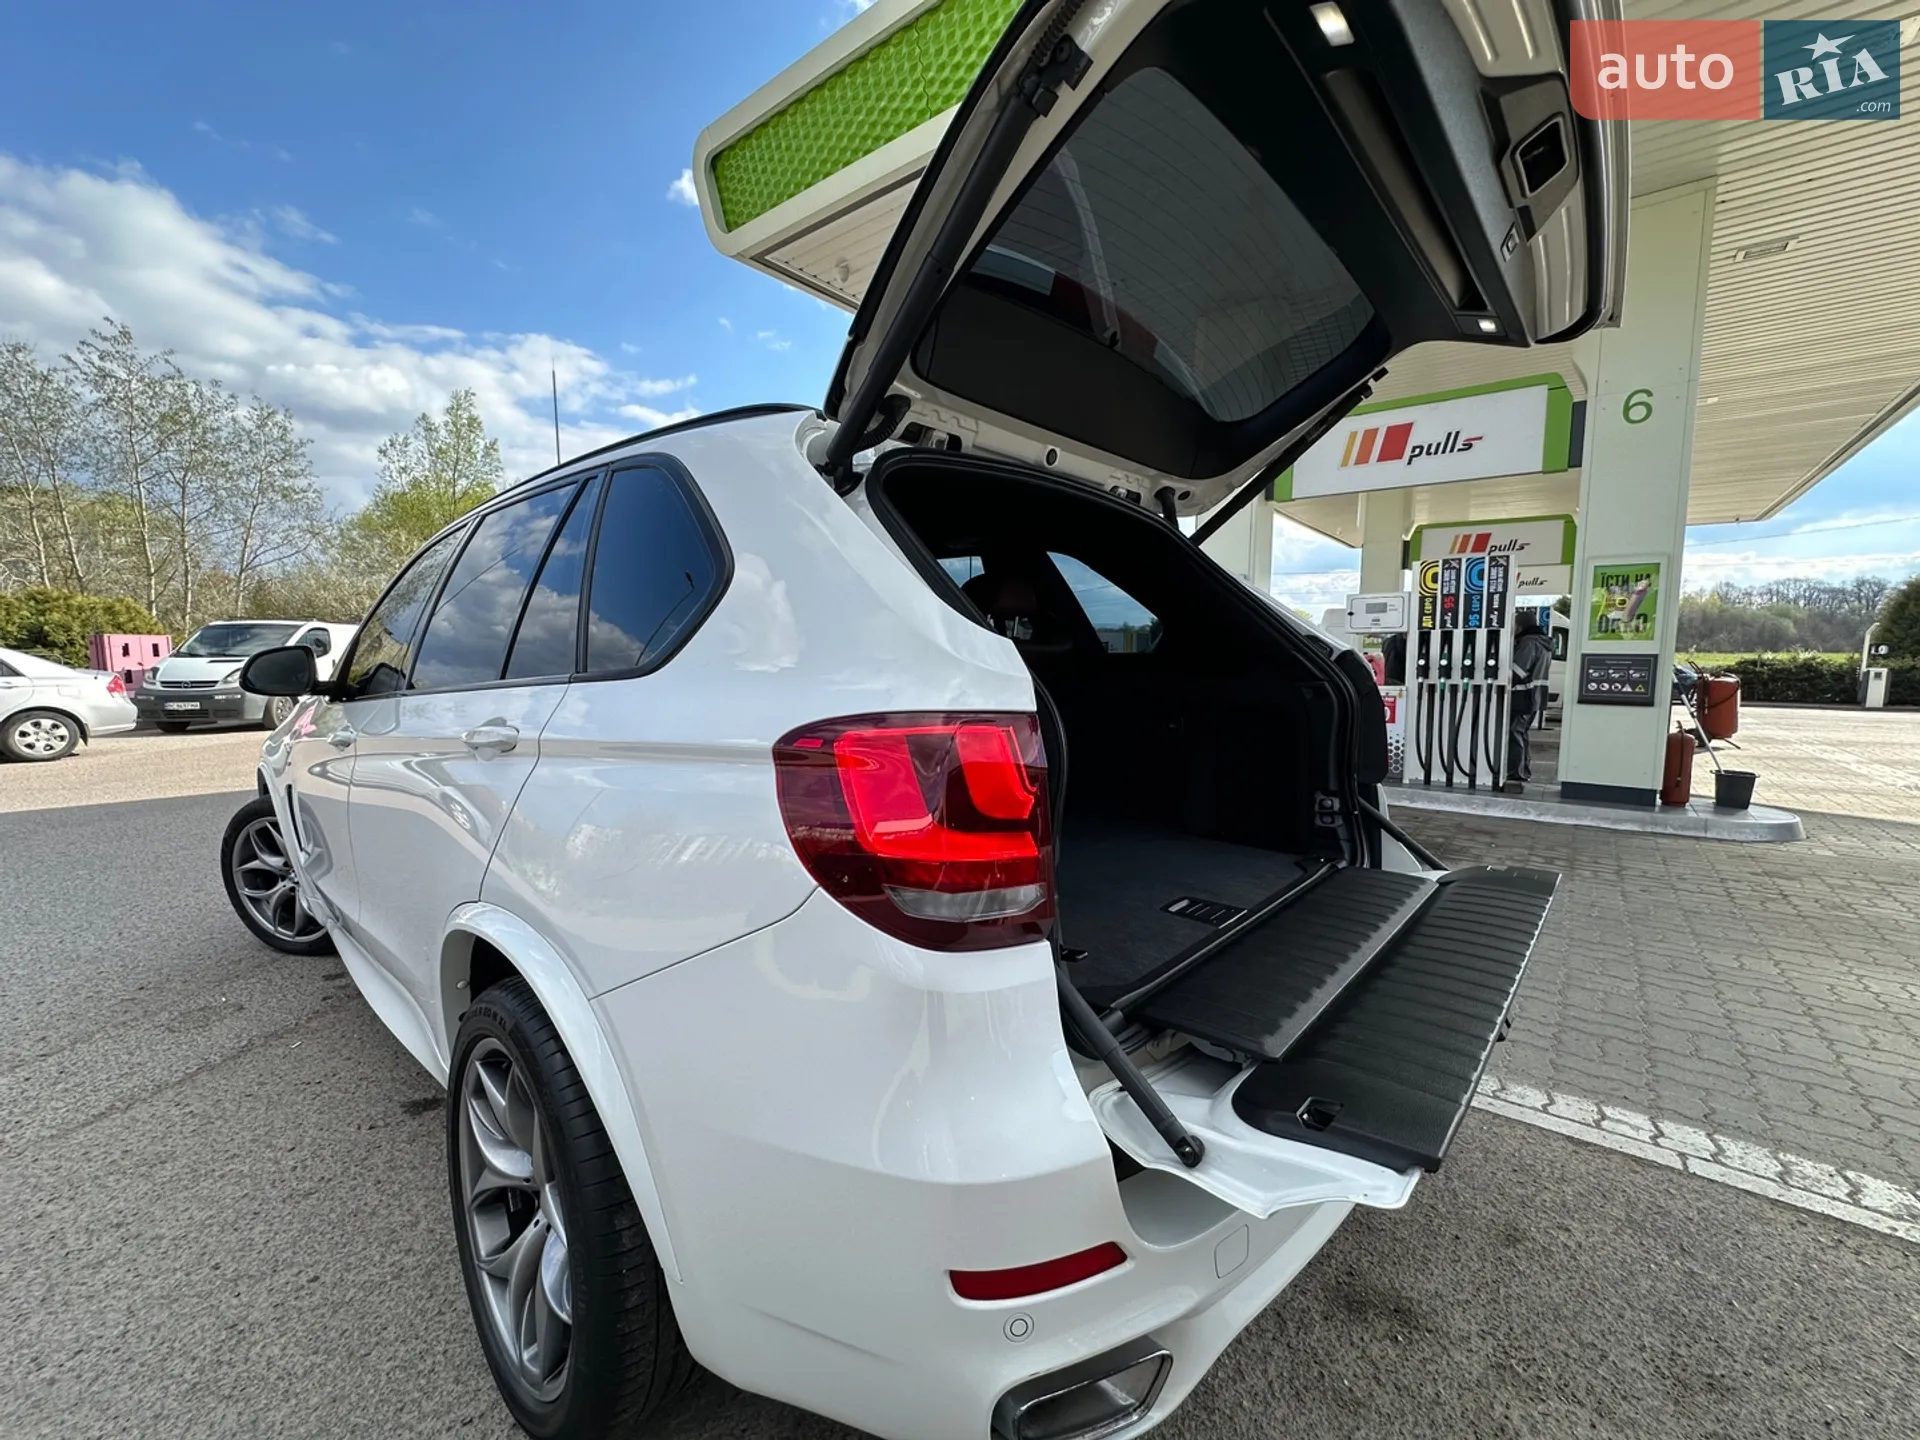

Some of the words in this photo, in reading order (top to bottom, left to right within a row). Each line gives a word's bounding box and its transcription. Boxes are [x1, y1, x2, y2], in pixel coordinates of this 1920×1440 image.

[1623, 388, 1653, 425] 6
[1407, 431, 1483, 465] pulls
[1488, 539, 1530, 556] pulls
[1518, 577, 1548, 588] pulls
[1601, 572, 1630, 588] ЇСТИ
[1444, 596, 1455, 609] 95
[1468, 613, 1480, 627] 95
